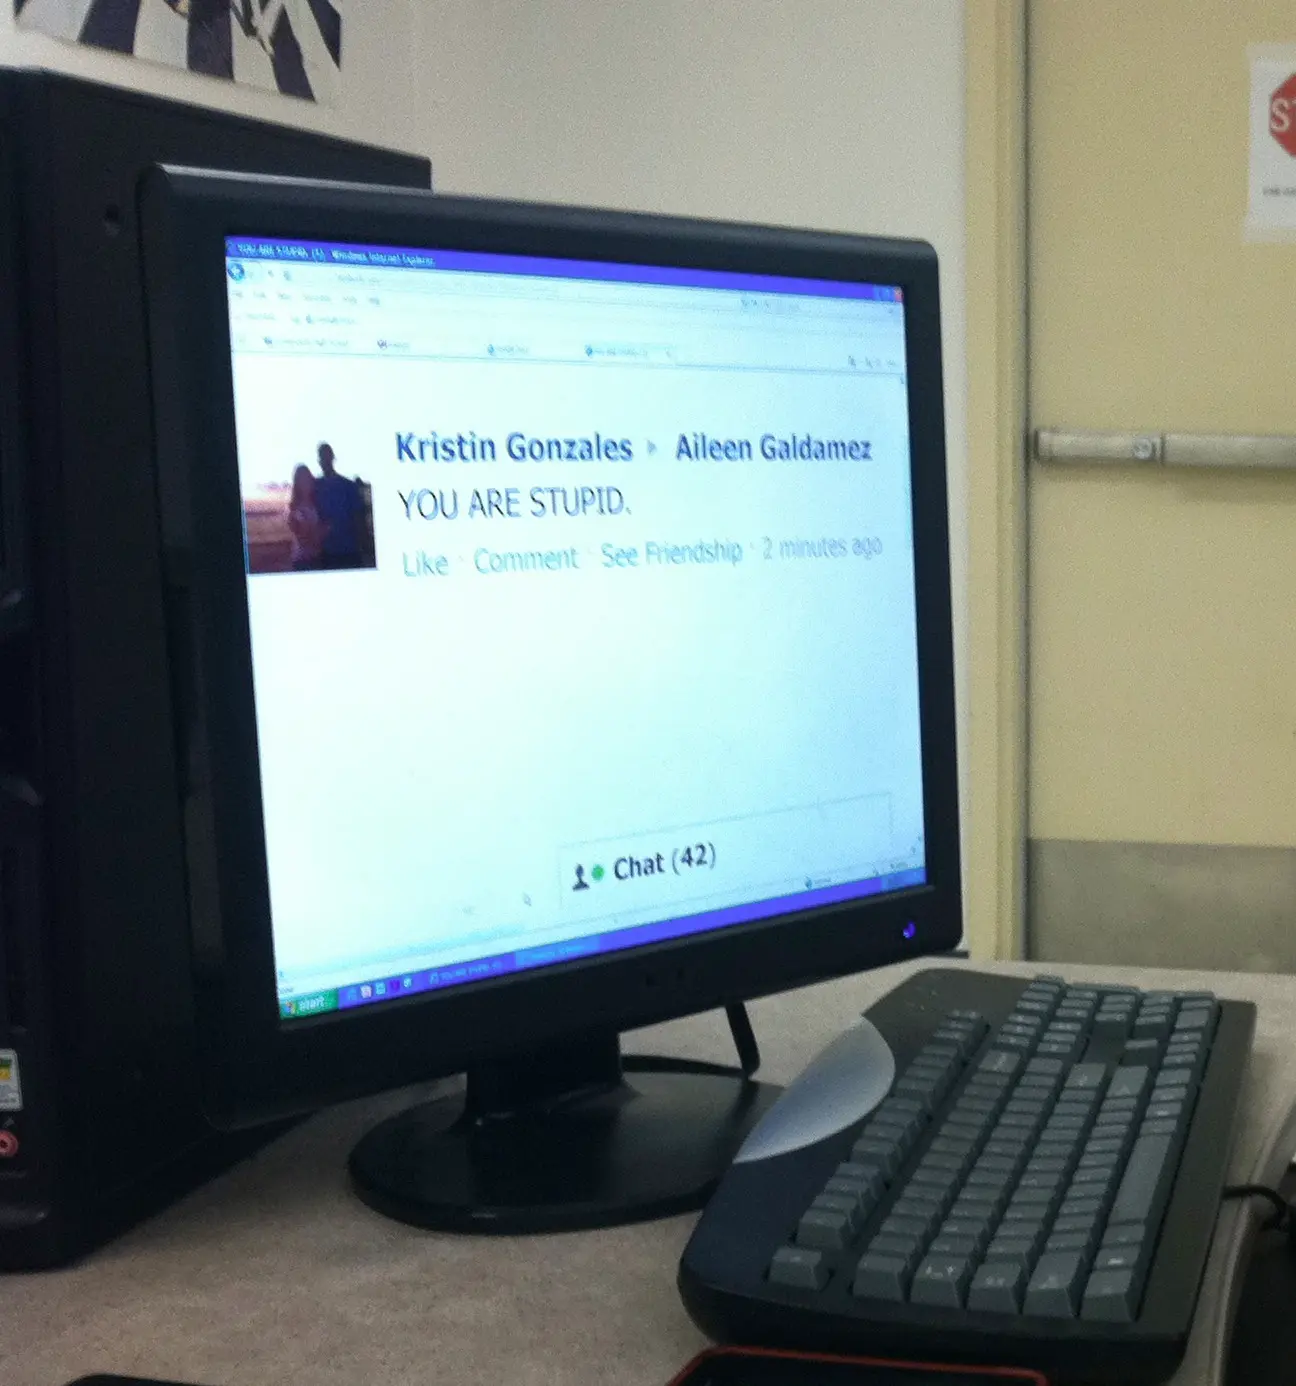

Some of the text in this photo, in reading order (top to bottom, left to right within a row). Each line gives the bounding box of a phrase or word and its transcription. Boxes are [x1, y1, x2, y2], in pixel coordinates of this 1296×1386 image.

[396, 431, 873, 463] Kristin Gonzales Aileen Galdamez
[397, 485, 632, 521] YOU ARE STUPID.
[402, 535, 883, 577] Like Comment See Friendship 2 minutes ago
[613, 841, 717, 880] Chat (42)
